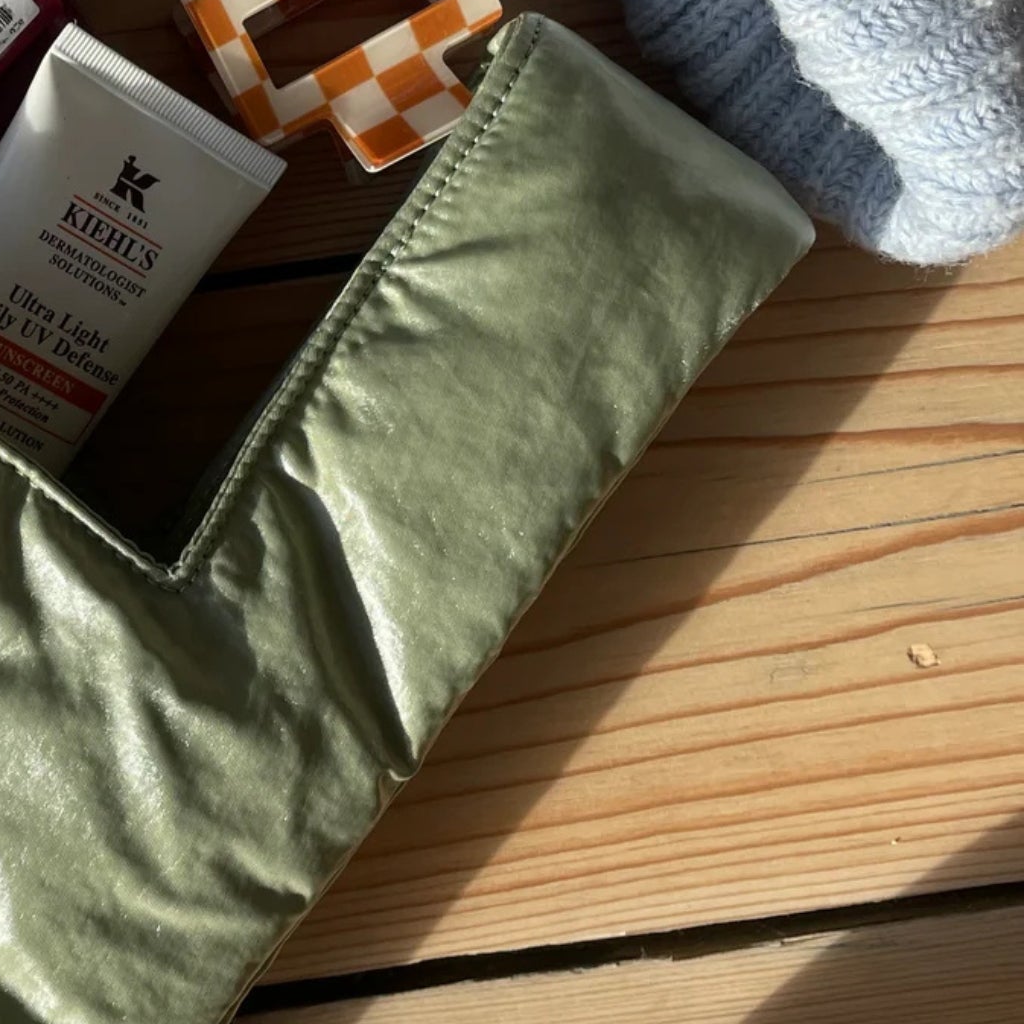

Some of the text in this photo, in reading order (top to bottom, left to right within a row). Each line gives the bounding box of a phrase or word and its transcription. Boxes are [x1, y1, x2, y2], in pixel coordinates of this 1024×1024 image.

[61, 201, 159, 271] KIEHL'S
[94, 192, 121, 213] SINCE
[39, 229, 147, 298] DERMATOLOGIST
[9, 284, 110, 354] Ultra Light
[20, 318, 54, 345] UV
[52, 338, 120, 389] Defense
[13, 380, 31, 396] PA
